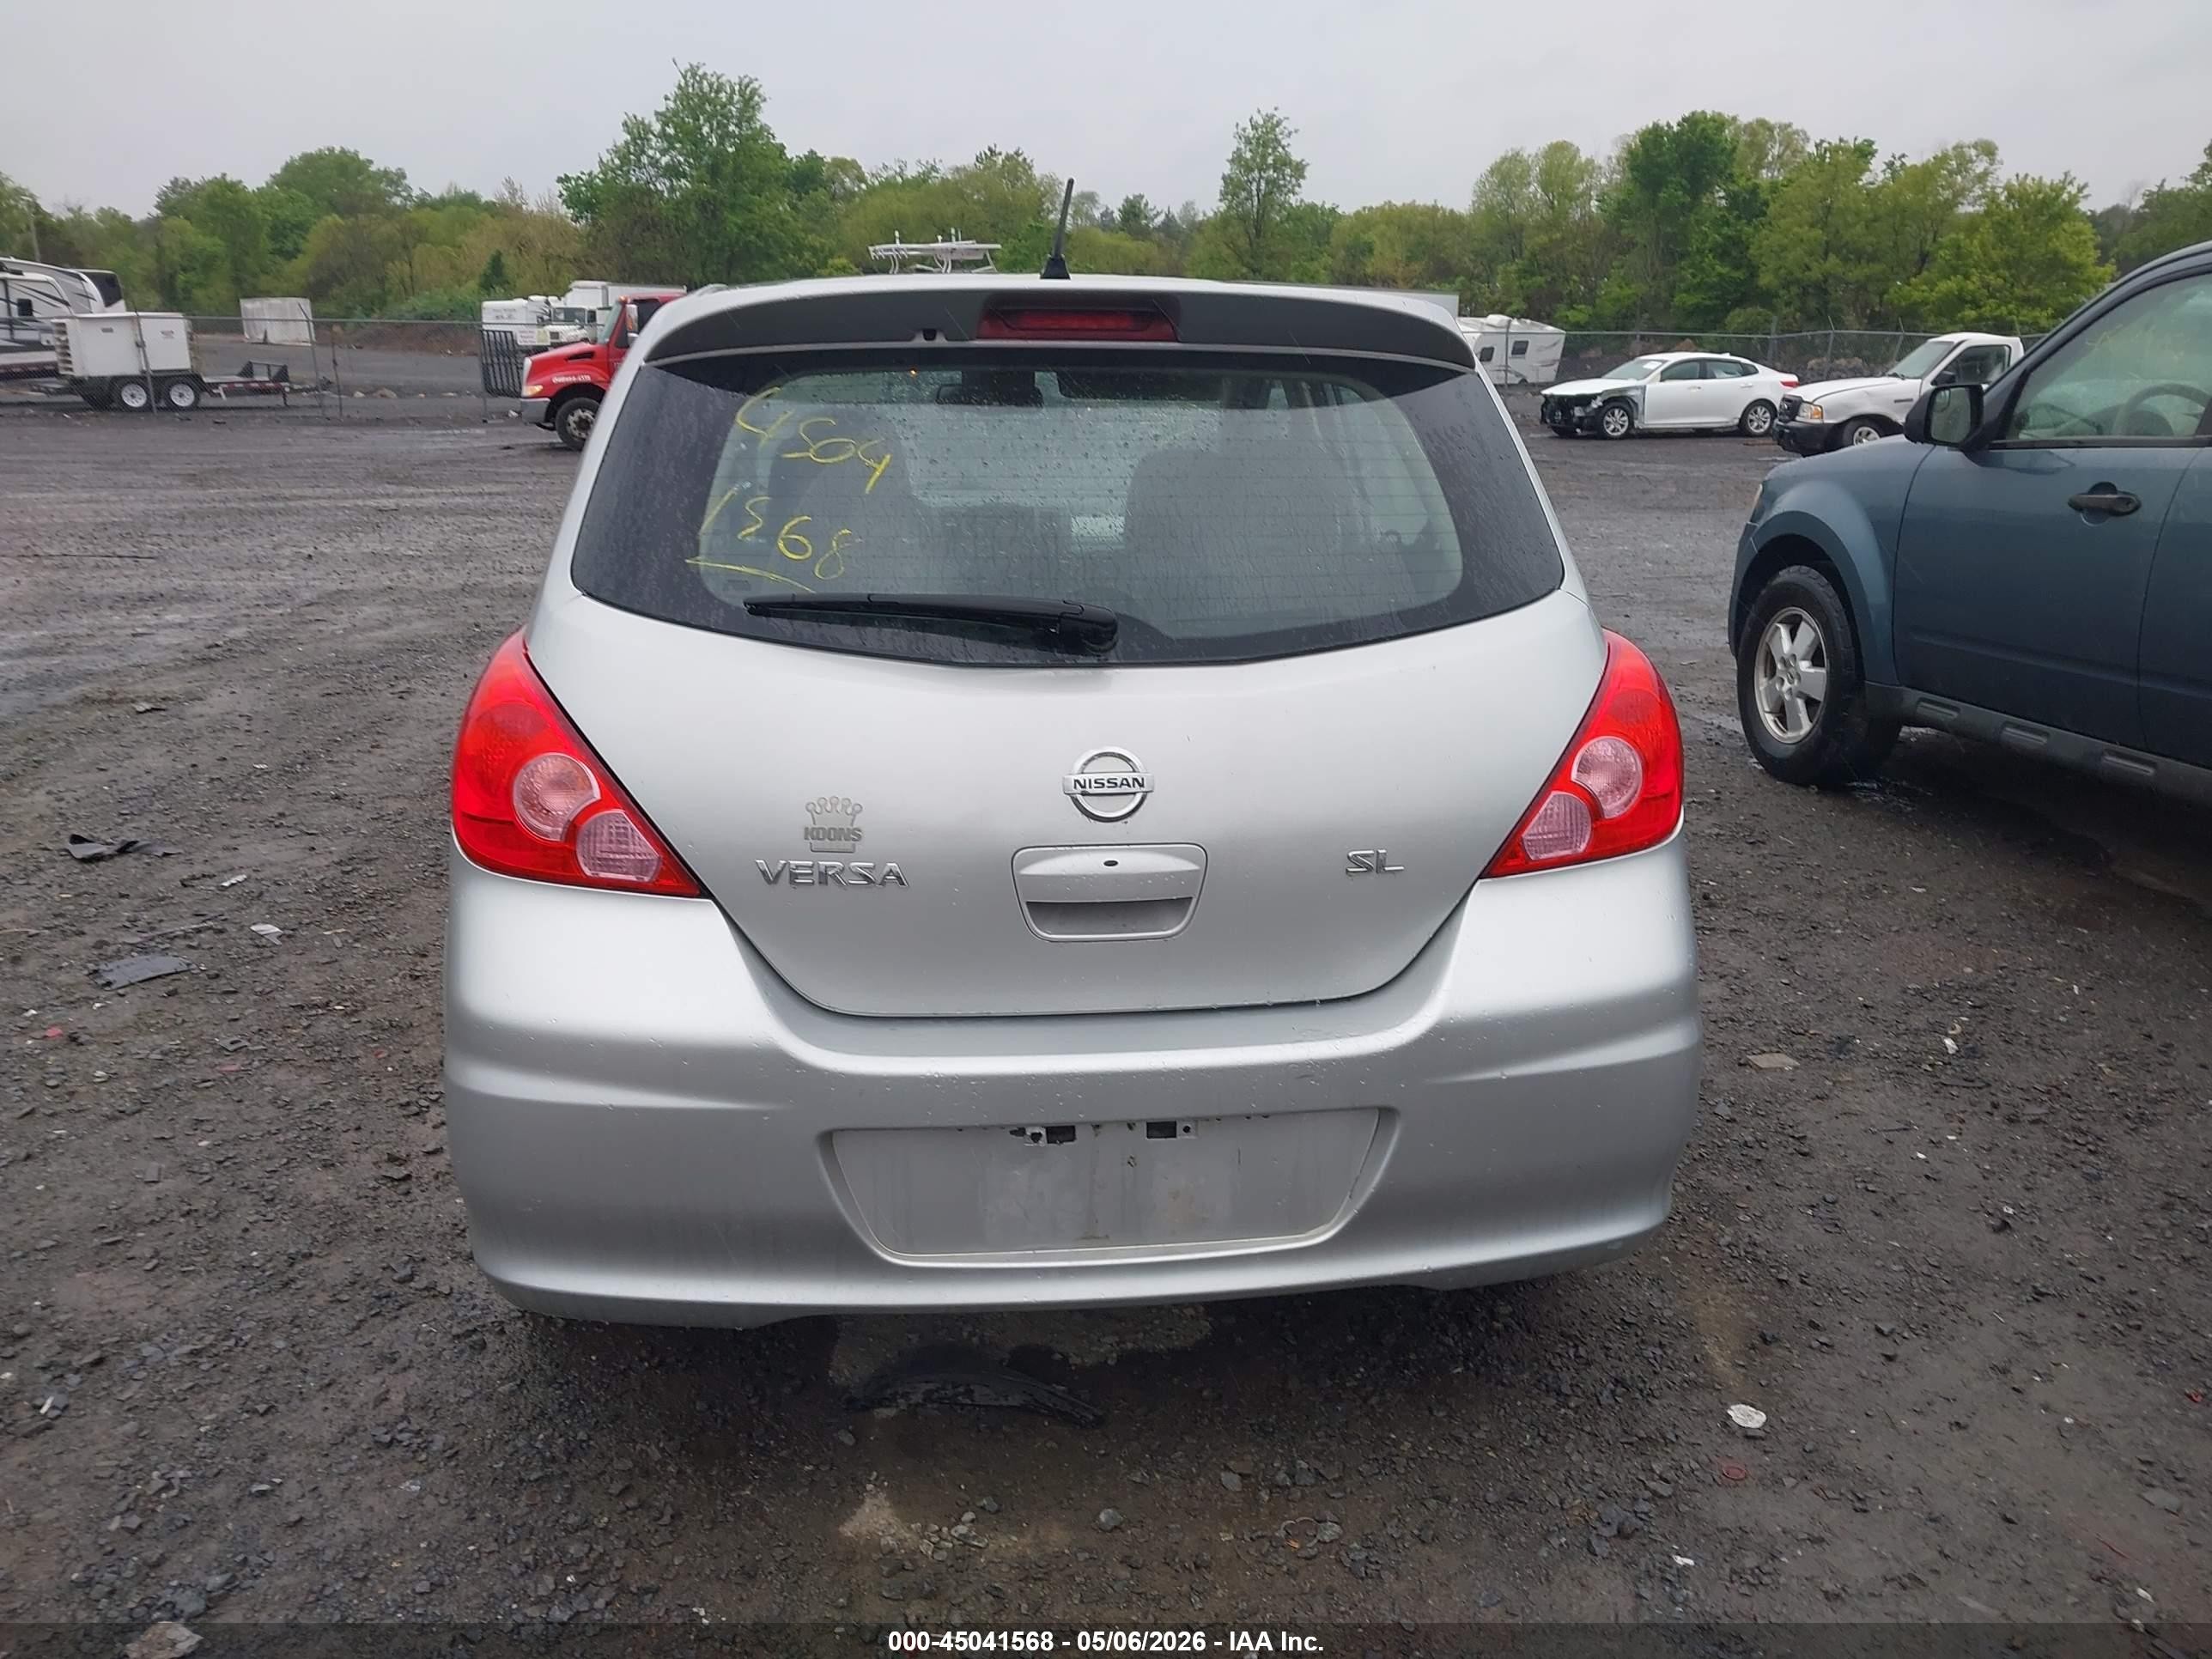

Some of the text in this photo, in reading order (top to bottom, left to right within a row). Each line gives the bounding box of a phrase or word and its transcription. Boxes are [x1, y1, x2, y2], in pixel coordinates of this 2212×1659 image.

[1073, 776, 1146, 790] NISSAN
[804, 826, 863, 842] KOONS
[1346, 848, 1405, 875] SL
[755, 859, 910, 888] VERSA
